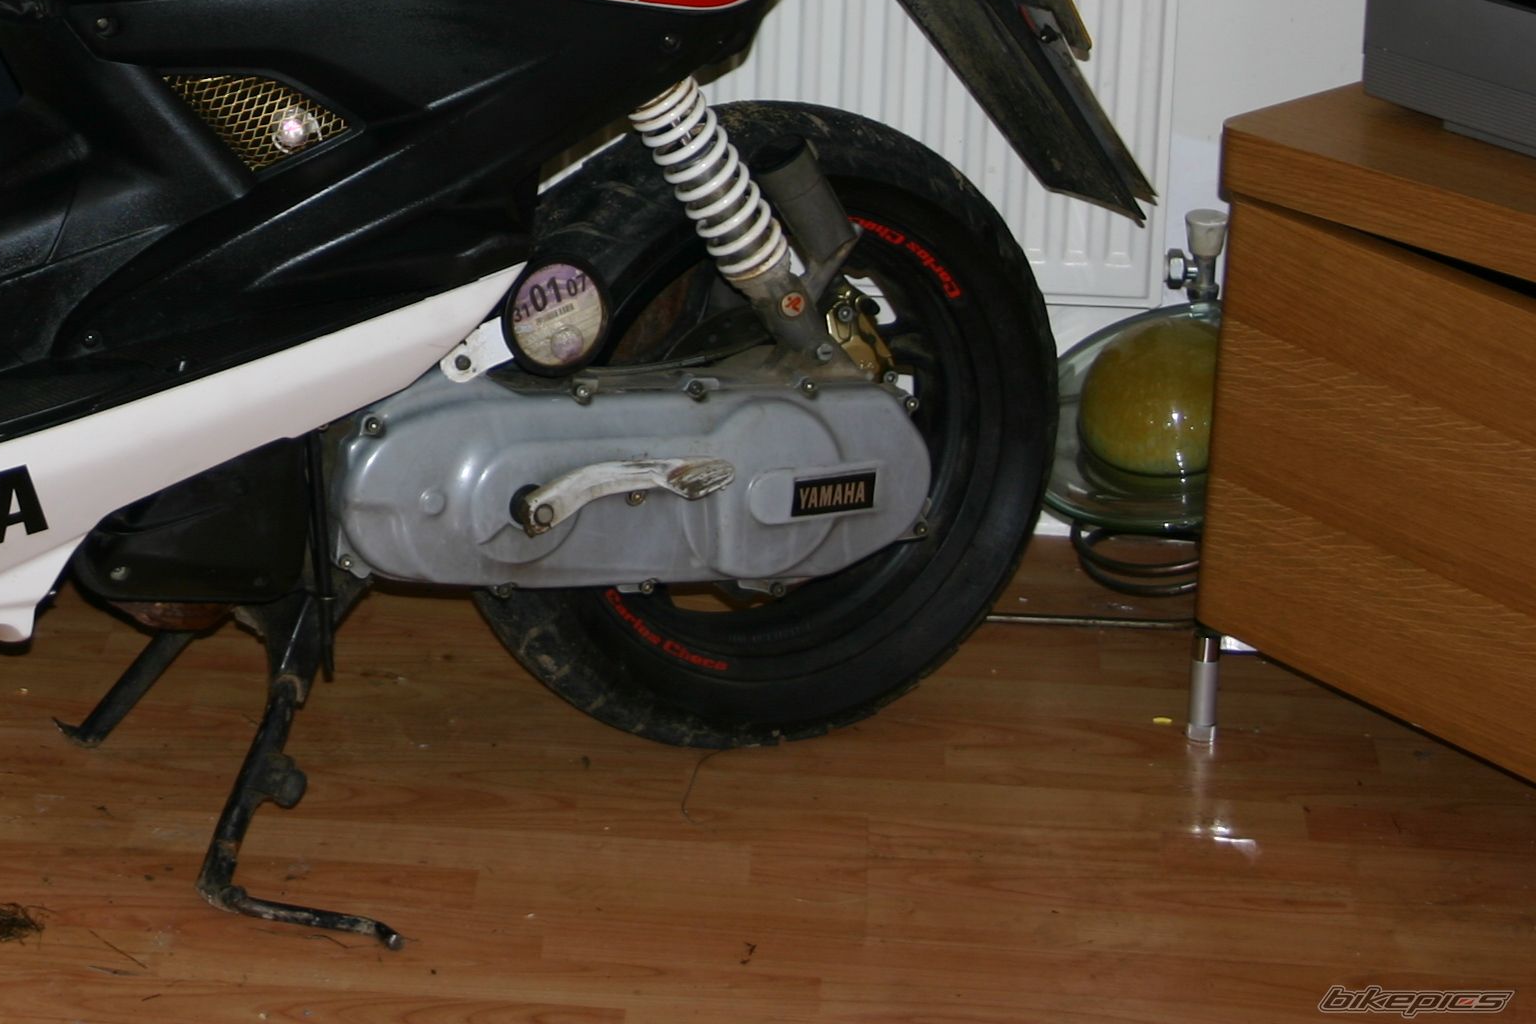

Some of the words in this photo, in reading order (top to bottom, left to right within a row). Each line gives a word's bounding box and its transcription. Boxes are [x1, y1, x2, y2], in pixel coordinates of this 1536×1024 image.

[906, 242, 961, 299] Carlos
[513, 302, 531, 323] 31
[529, 276, 562, 312] 01
[566, 273, 587, 296] 07
[799, 480, 866, 510] YAMAHA
[605, 588, 661, 645] Carlos
[663, 641, 729, 671] Checa
